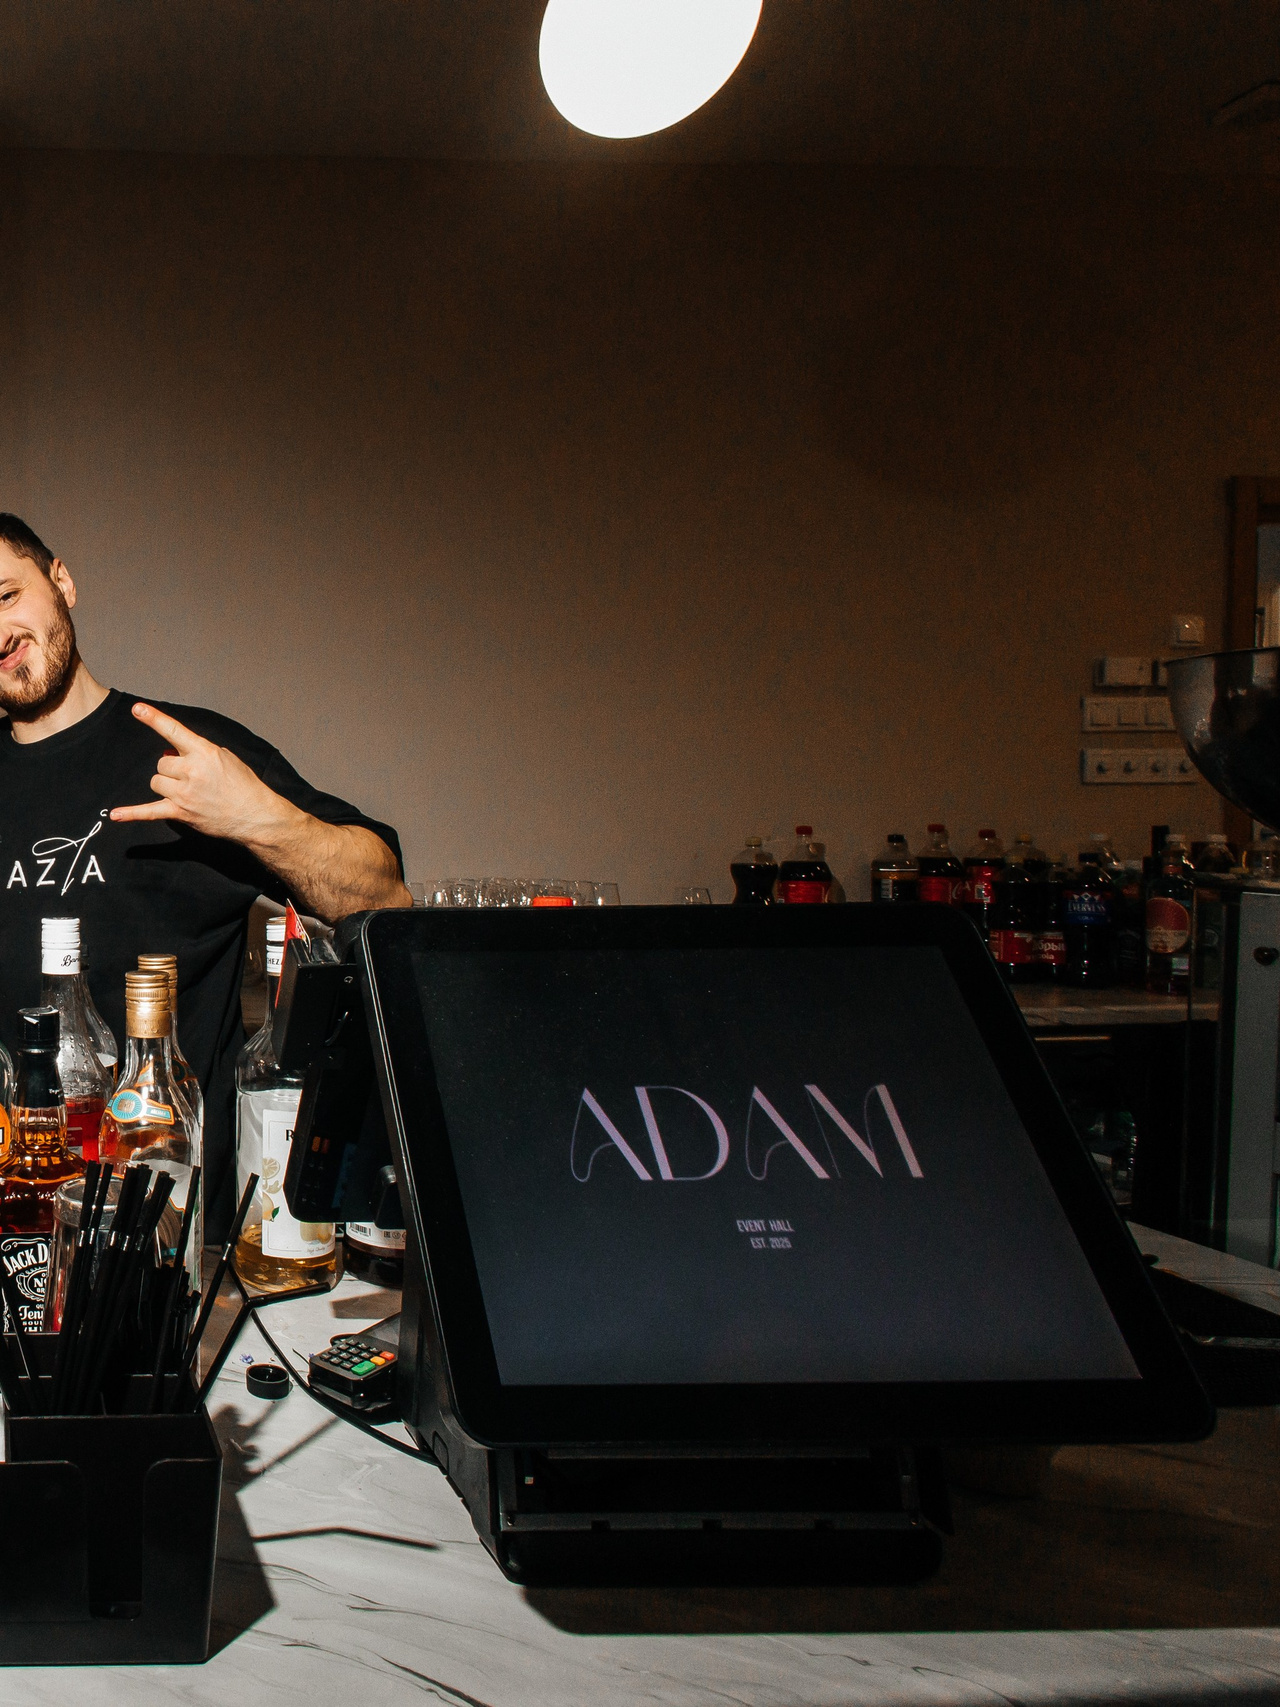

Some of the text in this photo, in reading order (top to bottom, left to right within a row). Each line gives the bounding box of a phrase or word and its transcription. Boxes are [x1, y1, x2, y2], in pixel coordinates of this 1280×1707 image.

[570, 1084, 925, 1183] ADAM
[736, 1219, 795, 1232] EVENT HALL
[2, 1248, 37, 1277] JACK
